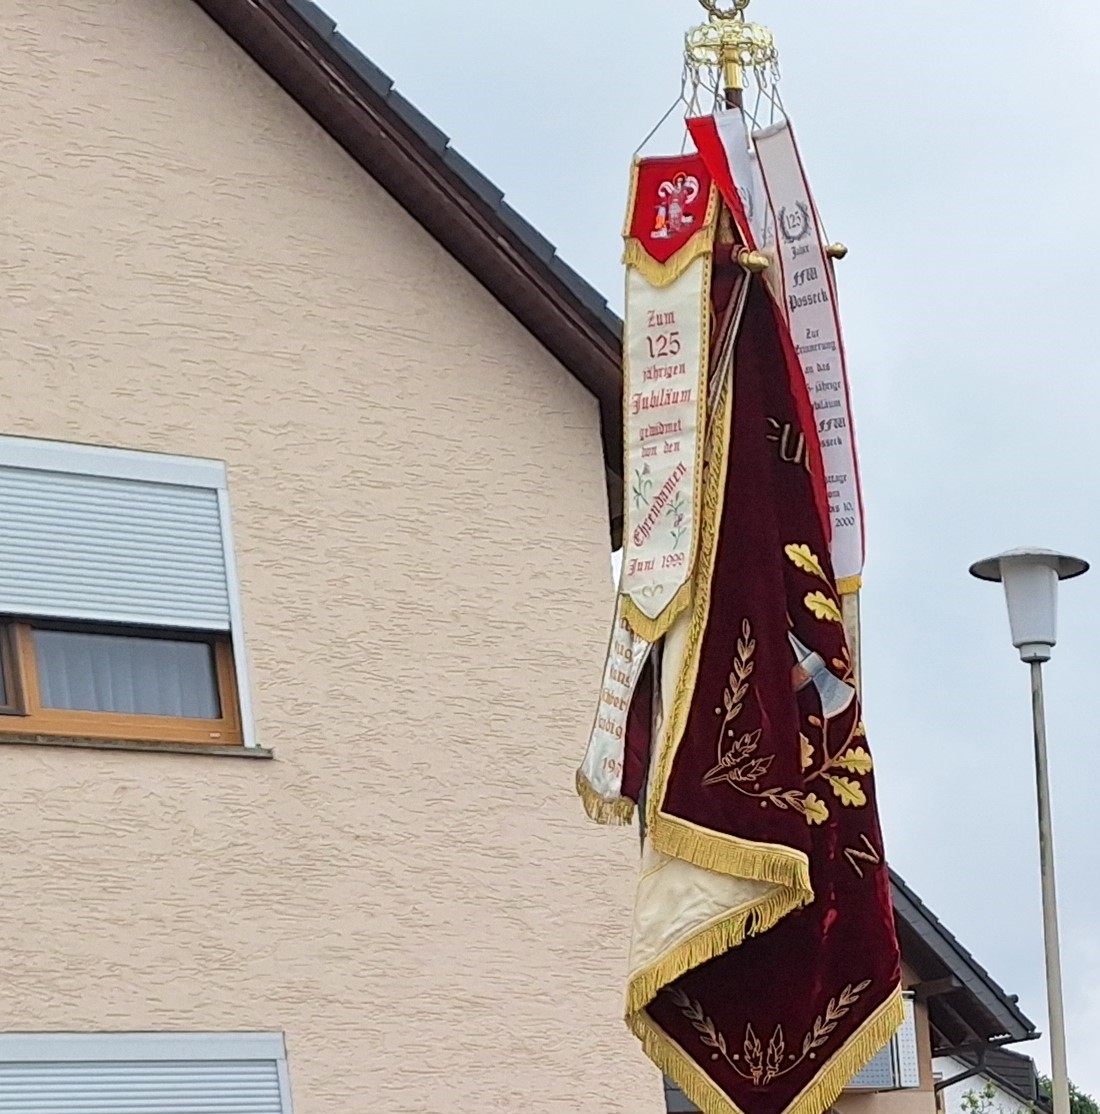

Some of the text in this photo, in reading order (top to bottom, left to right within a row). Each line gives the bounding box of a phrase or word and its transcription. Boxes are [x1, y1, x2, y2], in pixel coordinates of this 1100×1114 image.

[786, 211, 801, 229] 125
[788, 288, 829, 313] Posseck
[647, 309, 675, 328] Zum
[805, 328, 820, 339] Zur
[646, 331, 681, 358] 125
[642, 363, 686, 383] jährigen
[816, 362, 831, 372] das
[632, 388, 692, 415] Jubiläum
[663, 440, 681, 454] den
[820, 435, 843, 448] sseck
[633, 461, 687, 547] Ehrendamen
[628, 552, 686, 577] Juni 1999
